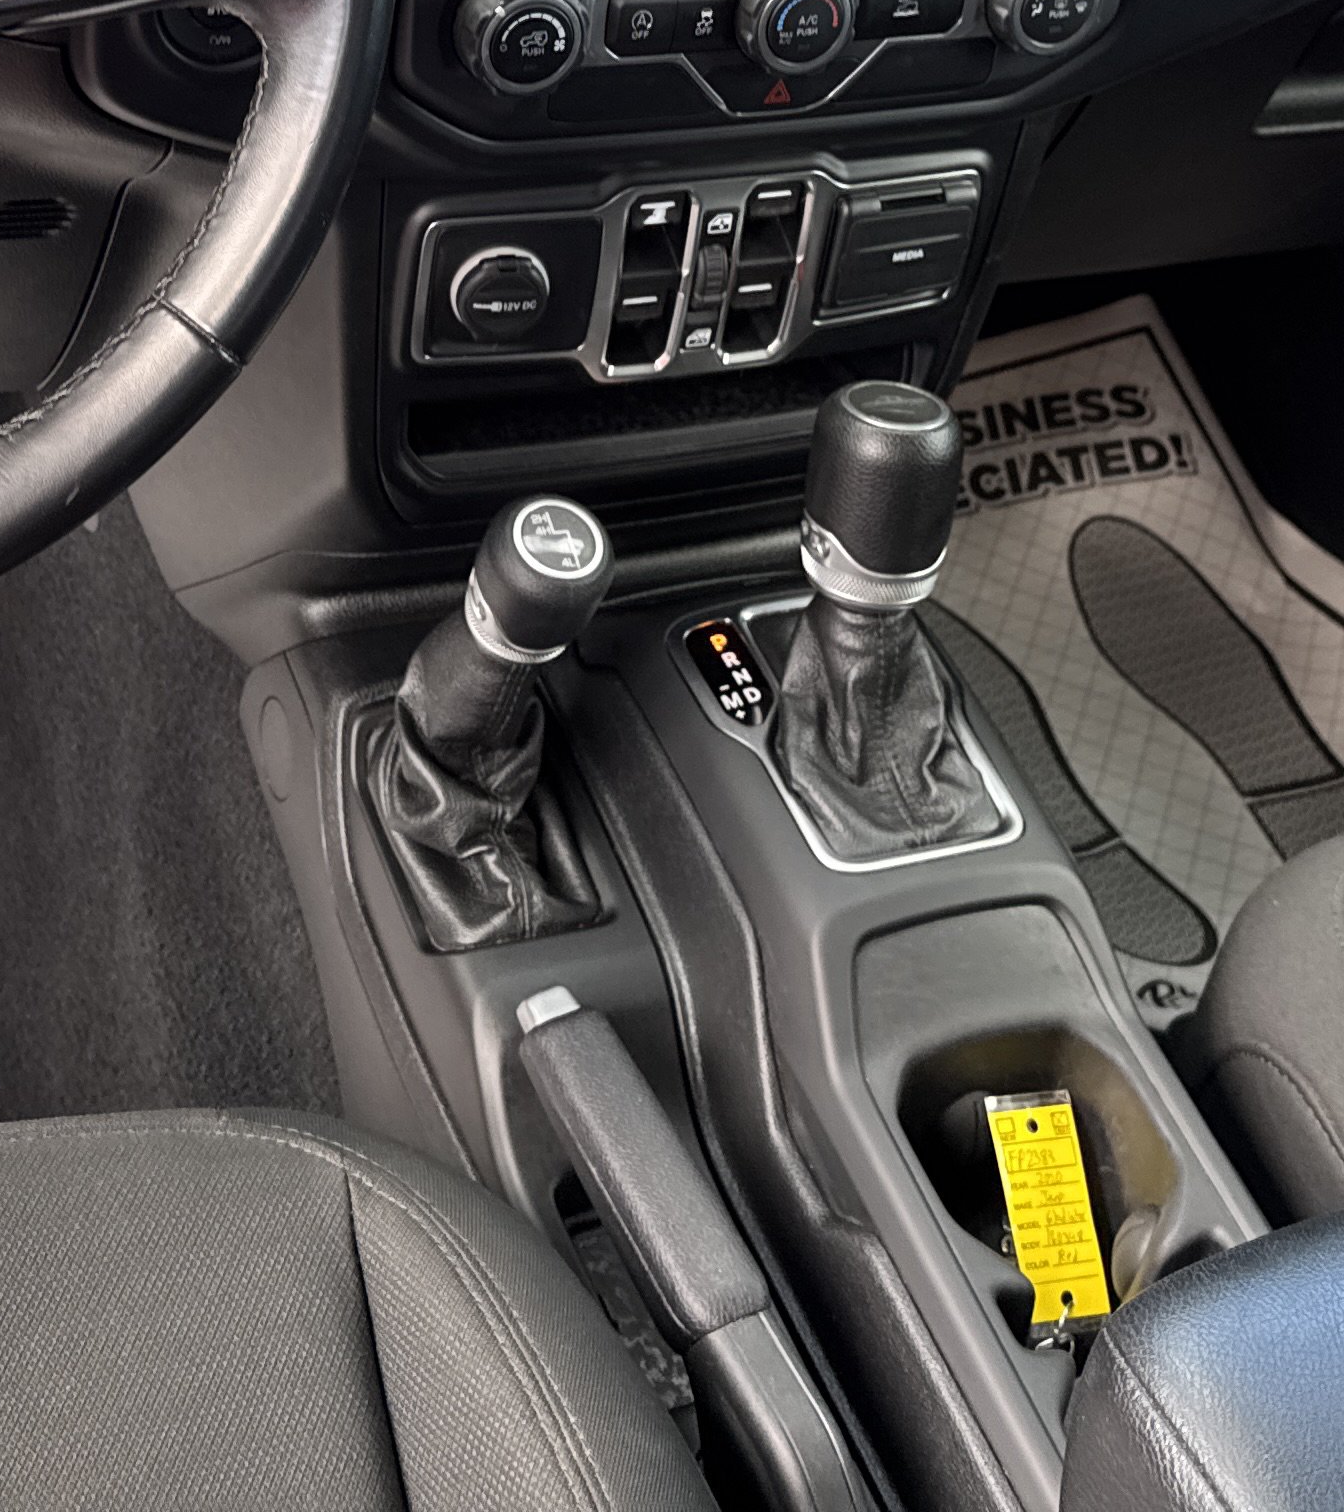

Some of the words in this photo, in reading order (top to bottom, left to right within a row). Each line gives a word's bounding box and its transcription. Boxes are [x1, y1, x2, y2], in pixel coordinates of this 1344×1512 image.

[799, 14, 818, 26] A/C
[632, 31, 649, 40] OFF
[695, 27, 712, 36] OFF
[796, 27, 818, 38] PUSH
[521, 46, 545, 56] PUSH
[892, 248, 924, 263] MEDIA
[522, 299, 537, 311] DC
[956, 384, 1148, 448] SINESS
[530, 512, 548, 525] 2H
[535, 525, 553, 536] 4H
[710, 633, 728, 652] P
[720, 651, 741, 669] R
[731, 668, 753, 686] N
[742, 686, 762, 704] D
